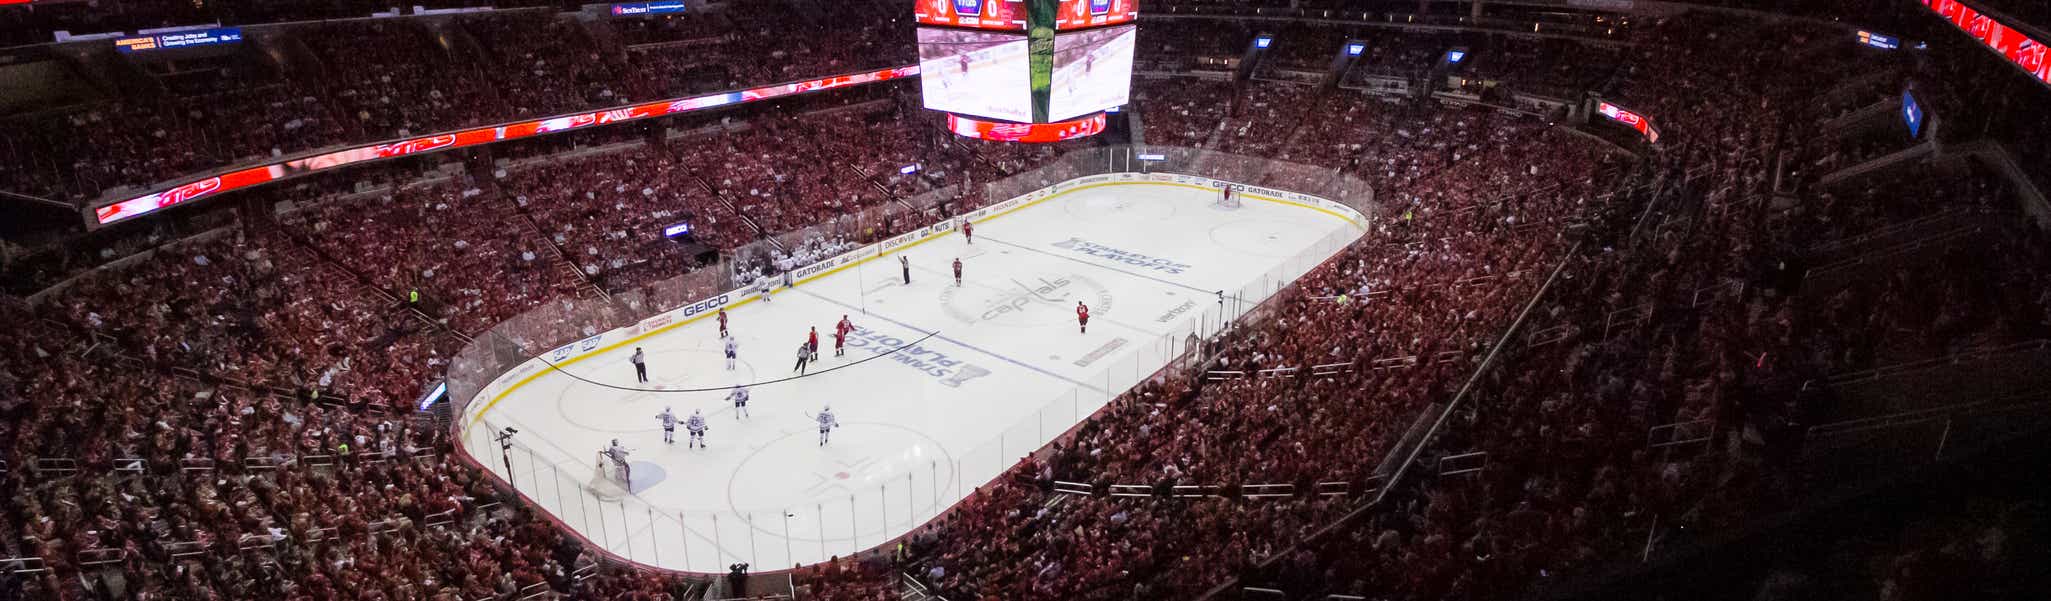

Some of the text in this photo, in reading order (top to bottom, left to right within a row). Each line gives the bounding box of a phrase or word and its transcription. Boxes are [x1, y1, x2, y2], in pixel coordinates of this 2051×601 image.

[1248, 187, 1283, 199] GATORADE
[885, 233, 915, 249] DISCOVER
[1077, 241, 1152, 260] STANLEY
[796, 260, 835, 279] GATORADE
[1072, 247, 1185, 275] PLAYOFFS
[684, 295, 729, 317] GEICO
